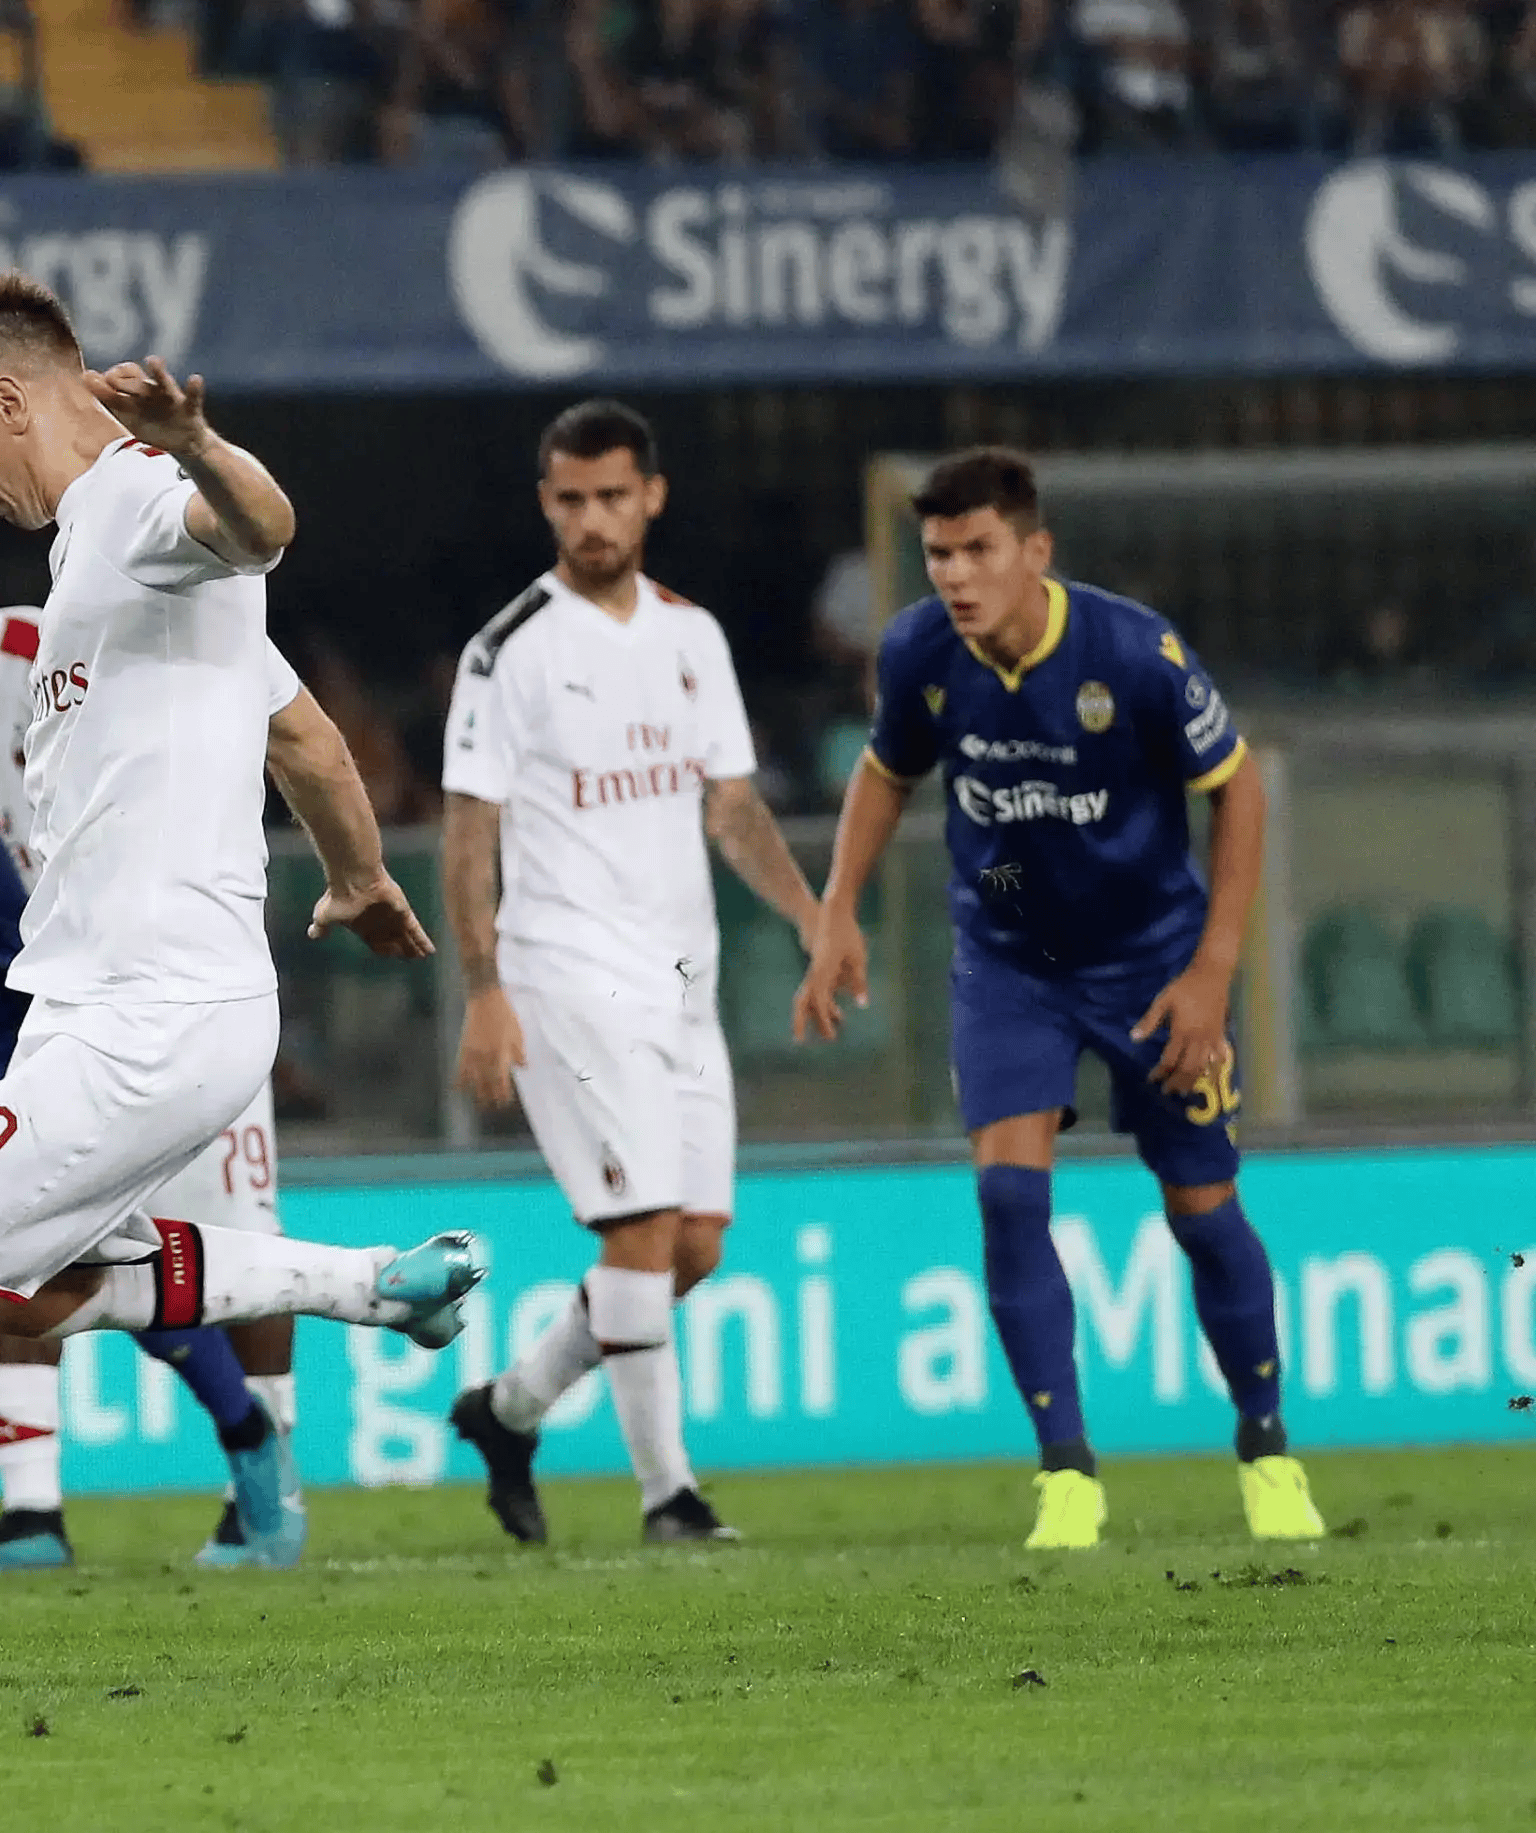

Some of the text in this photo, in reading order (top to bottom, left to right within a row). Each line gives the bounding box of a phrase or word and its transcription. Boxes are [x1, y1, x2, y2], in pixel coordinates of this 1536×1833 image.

[648, 184, 1070, 352] Sinergy
[218, 1124, 270, 1195] 79
[896, 1264, 988, 1416] a
